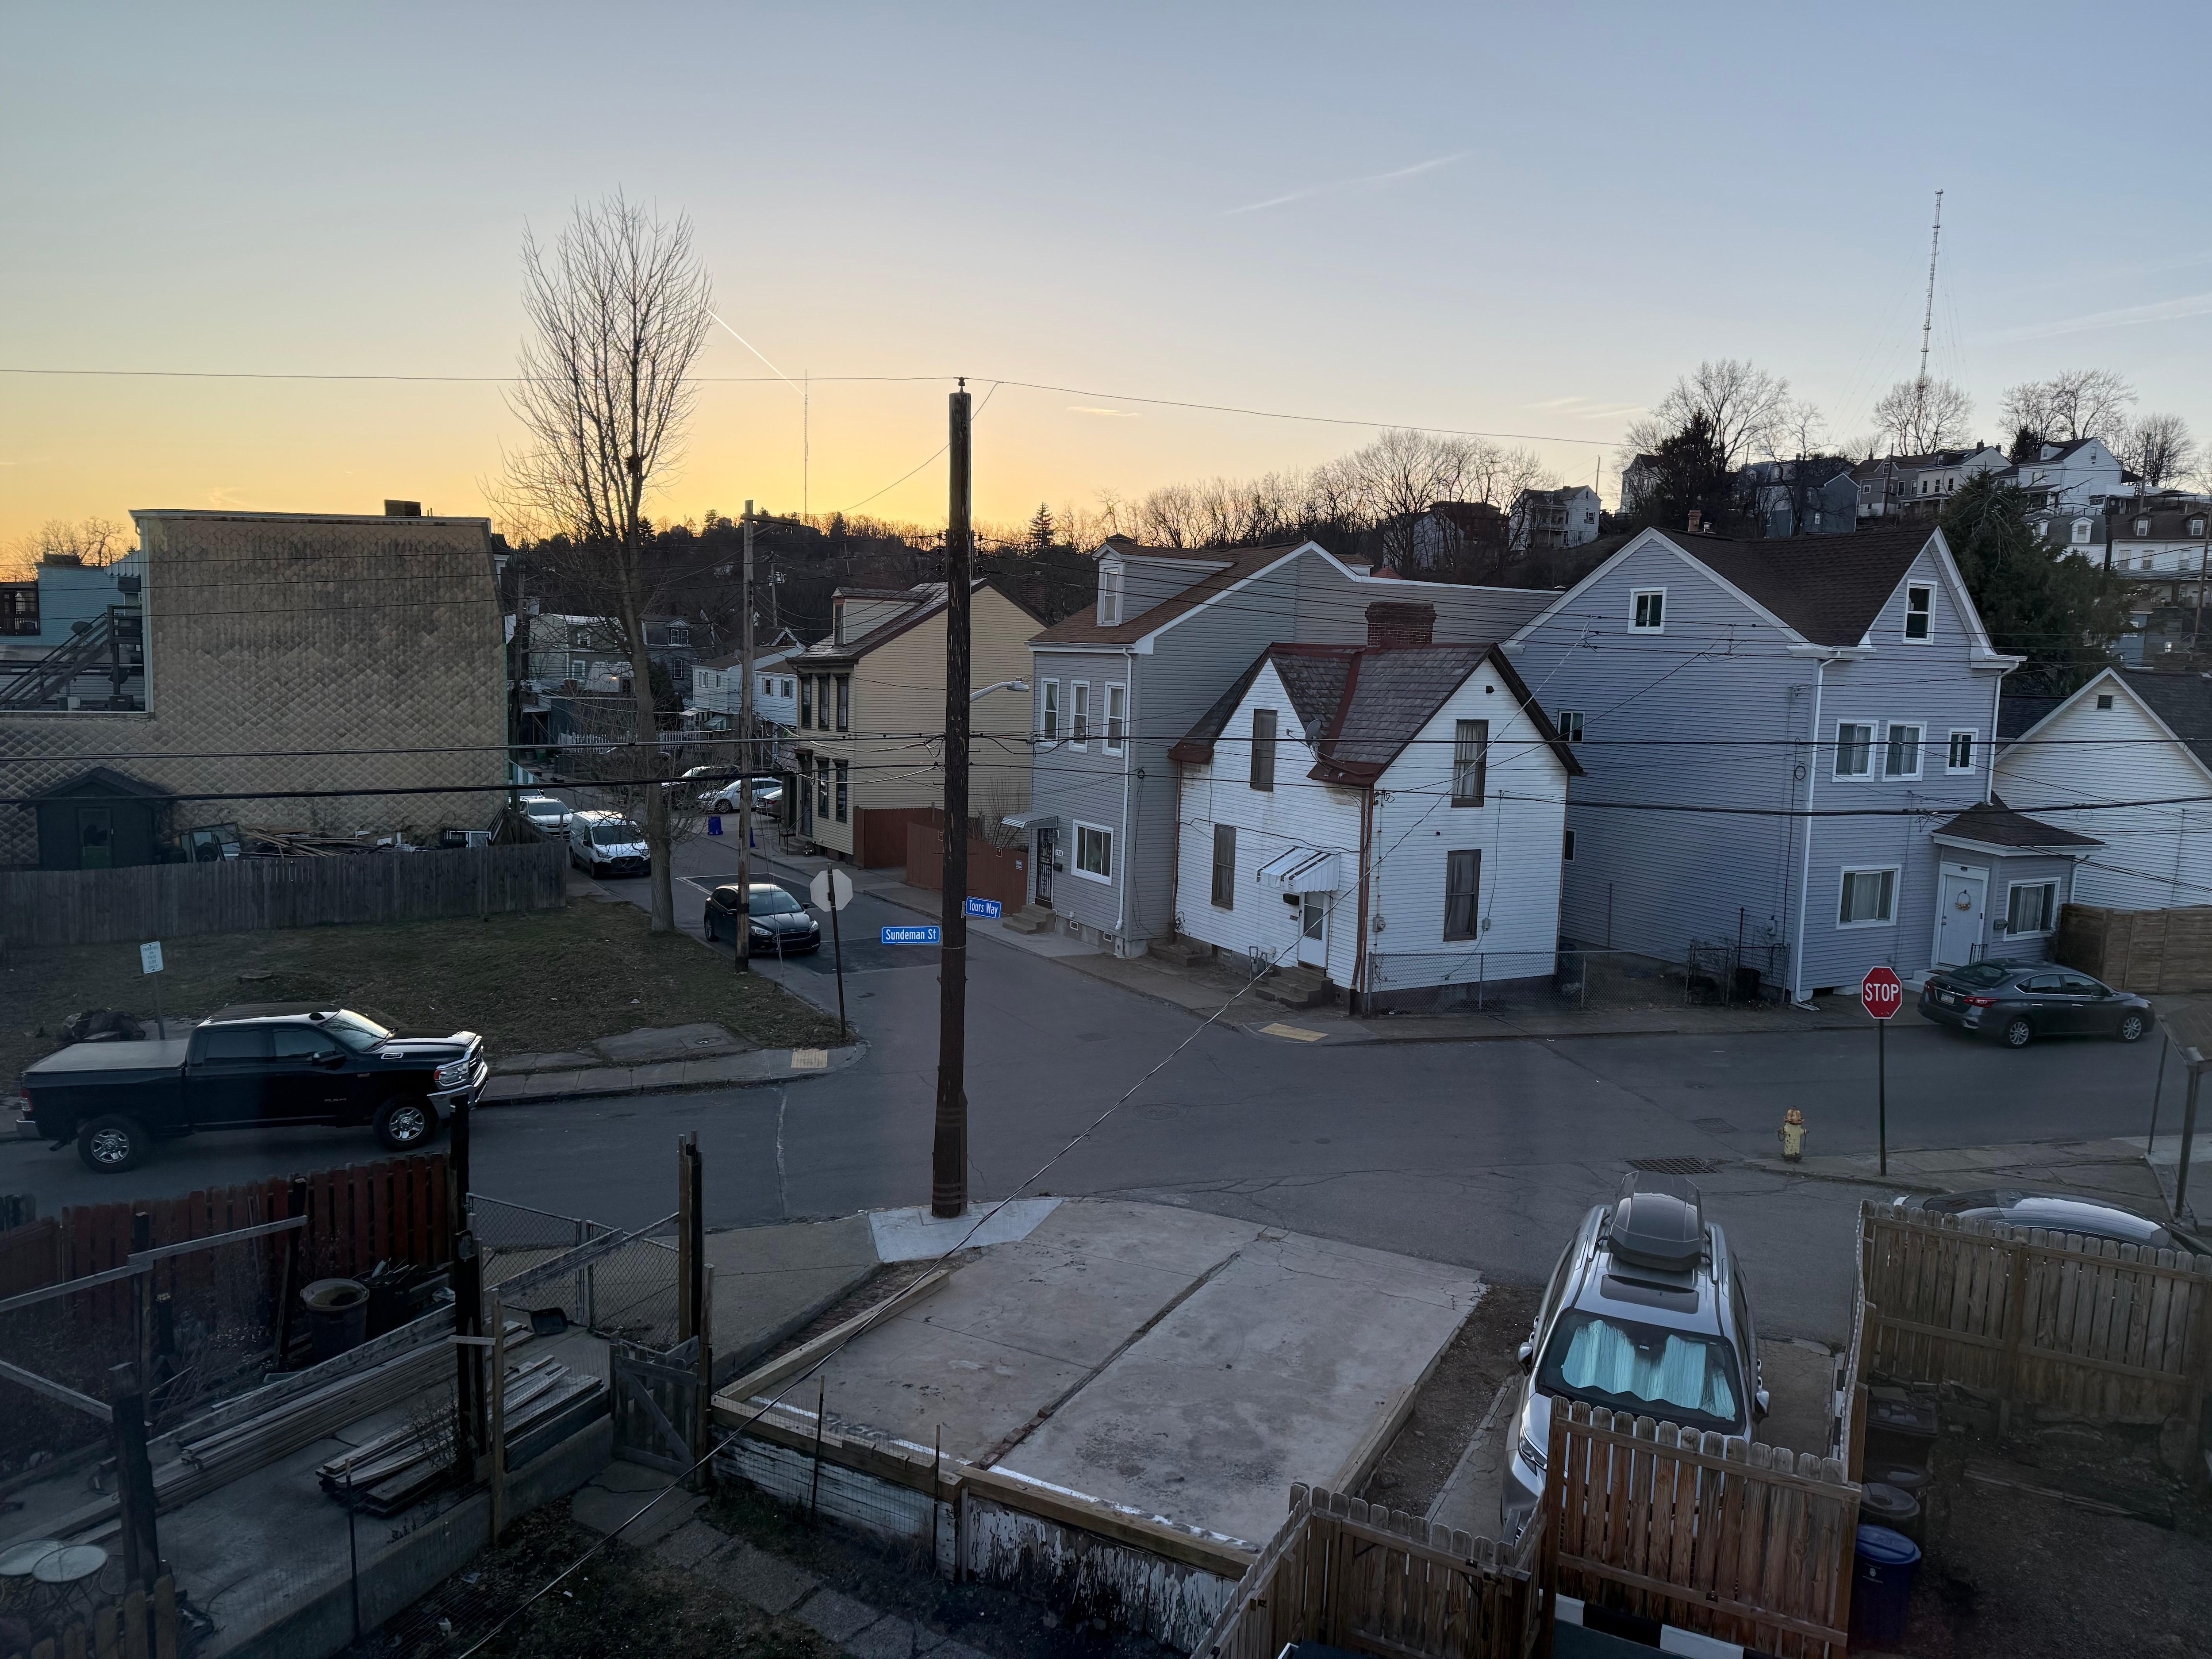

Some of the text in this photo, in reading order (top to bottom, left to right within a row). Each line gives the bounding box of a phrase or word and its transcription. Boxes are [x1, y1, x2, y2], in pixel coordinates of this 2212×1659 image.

[969, 900, 998, 918] Tours Way
[886, 929, 936, 940] Sundeman St
[1865, 983, 1899, 1002] STOP
